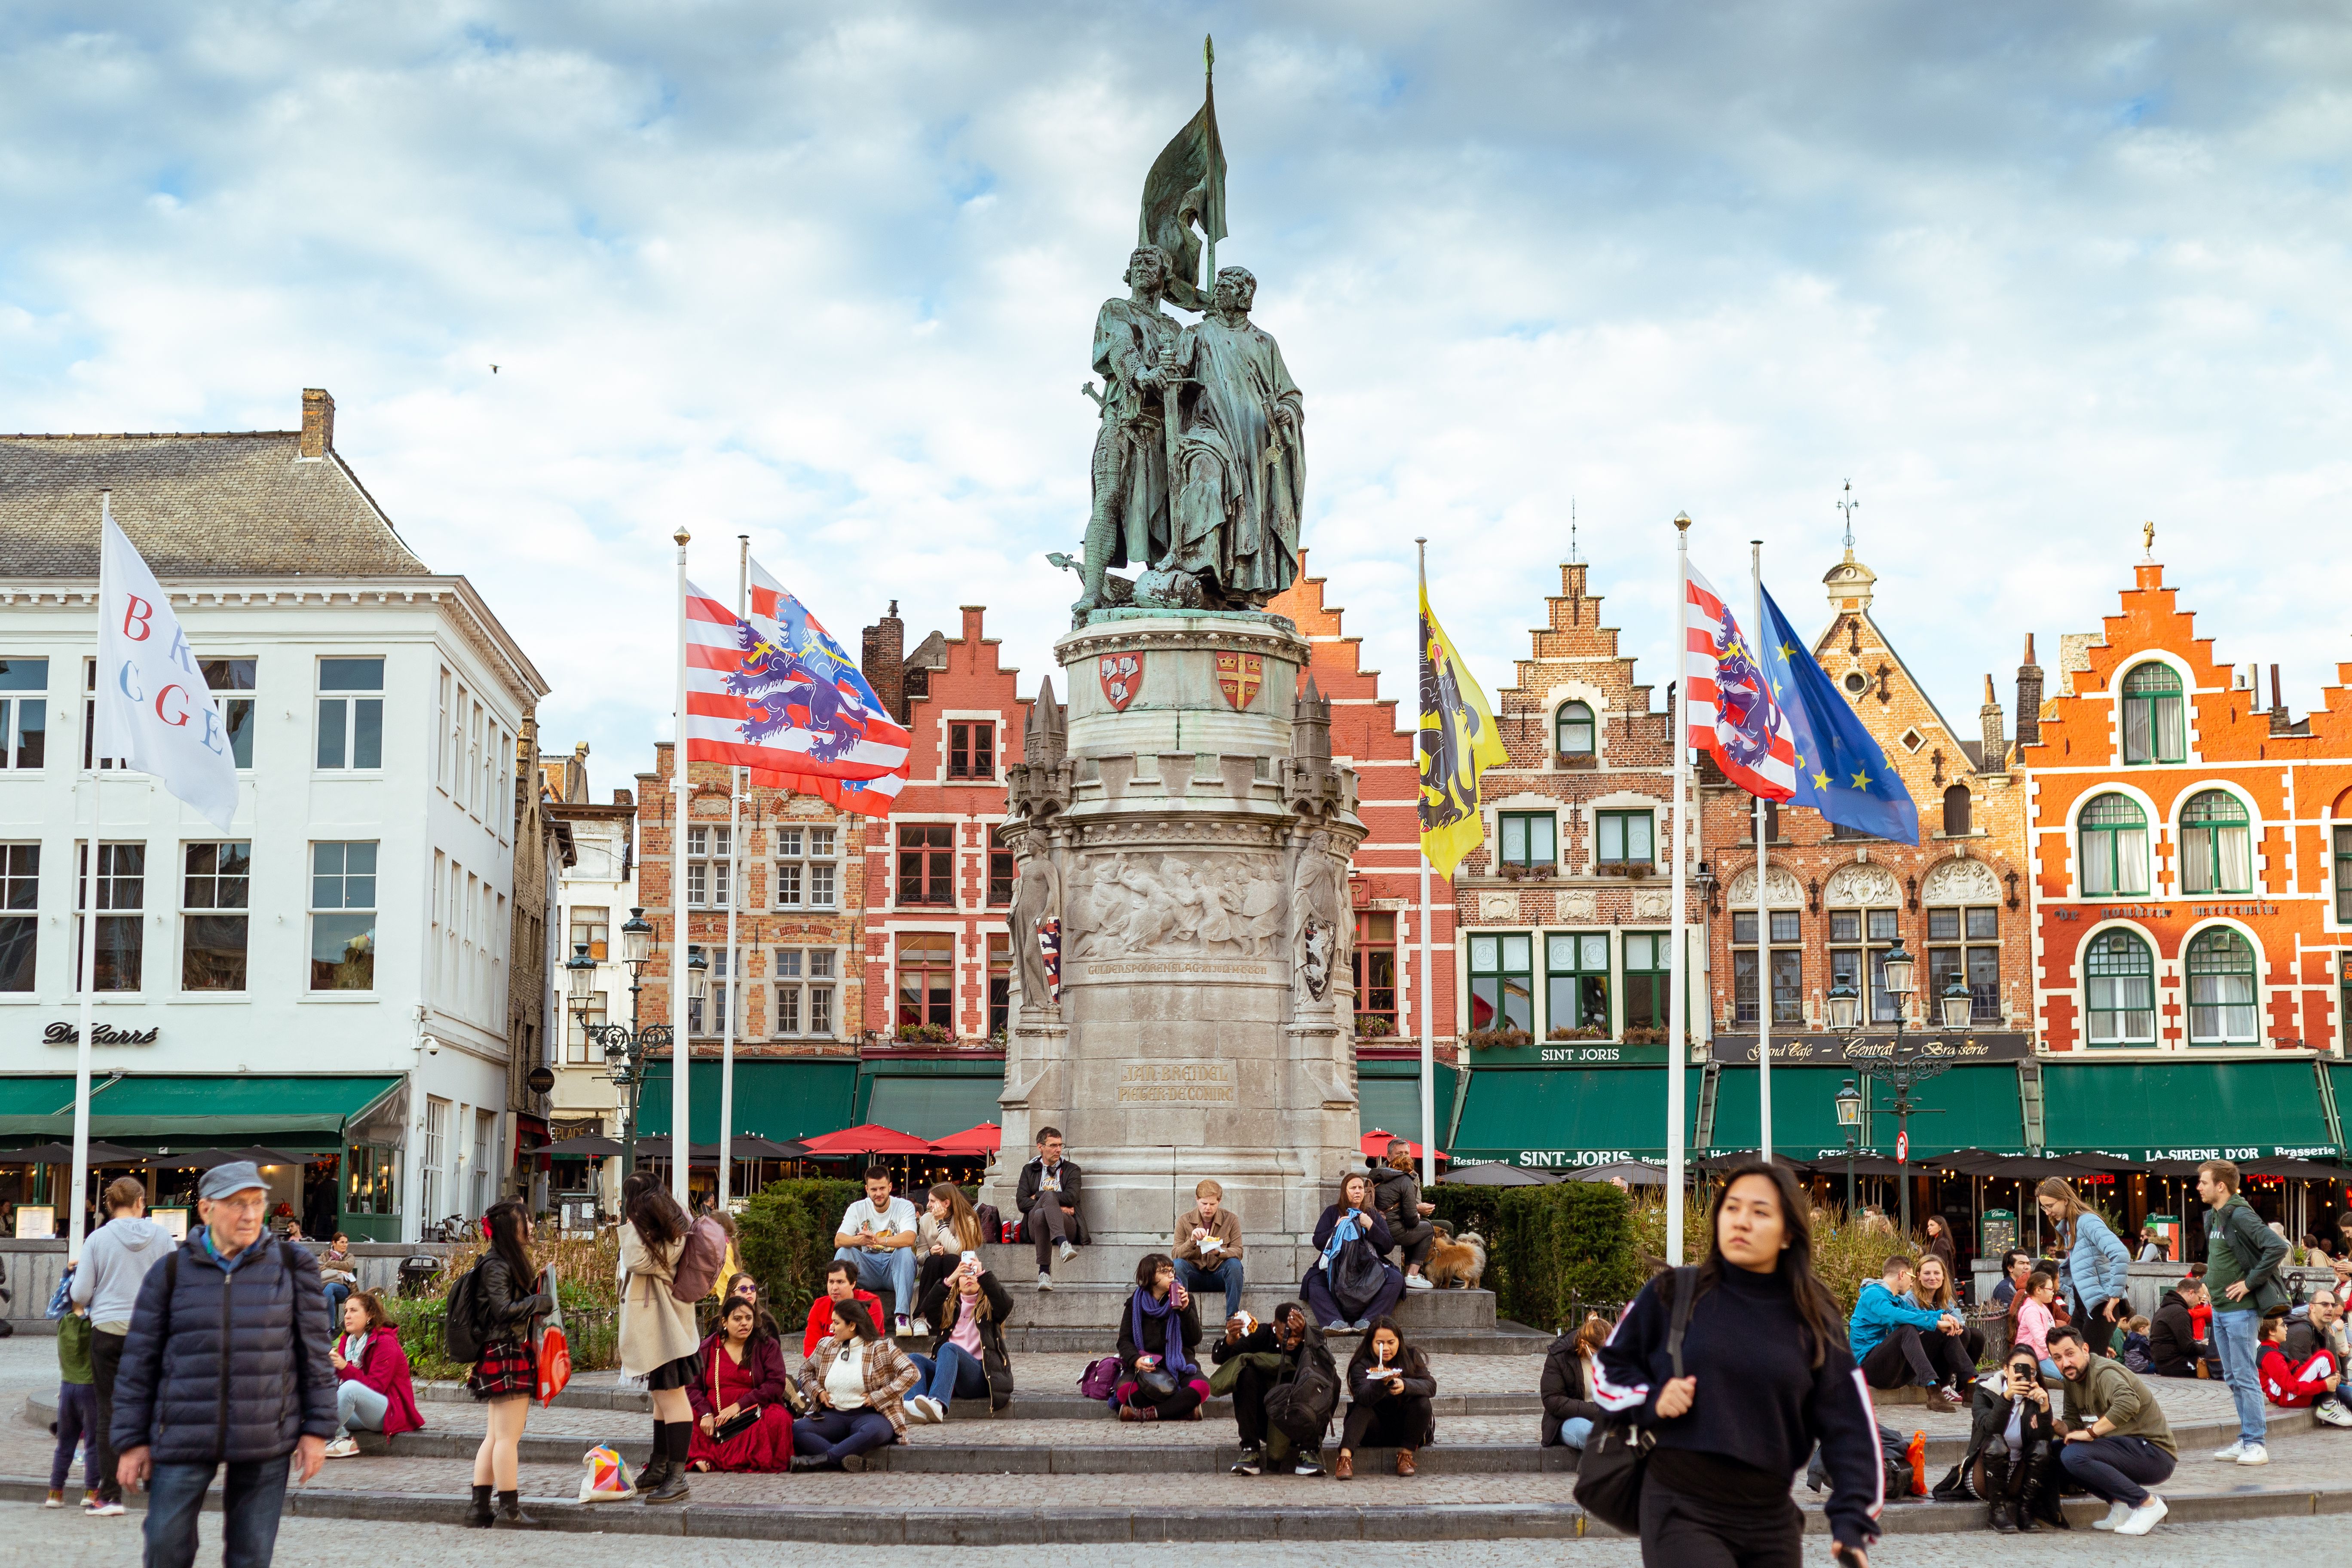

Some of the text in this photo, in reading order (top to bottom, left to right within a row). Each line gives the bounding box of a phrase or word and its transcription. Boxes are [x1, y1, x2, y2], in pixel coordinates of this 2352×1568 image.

[2059, 907, 2078, 921] de
[2101, 903, 2167, 921] gouden
[42, 1022, 159, 1044] De Carré
[1541, 1048, 1620, 1061] SINT JORIS
[1747, 1043, 1787, 1061] Gand
[1921, 1041, 1989, 1056] Braserie
[2169, 1149, 2220, 1161] SIRENE
[2225, 1148, 2260, 1160] D'OR
[2274, 1147, 2336, 1157] Brasserie
